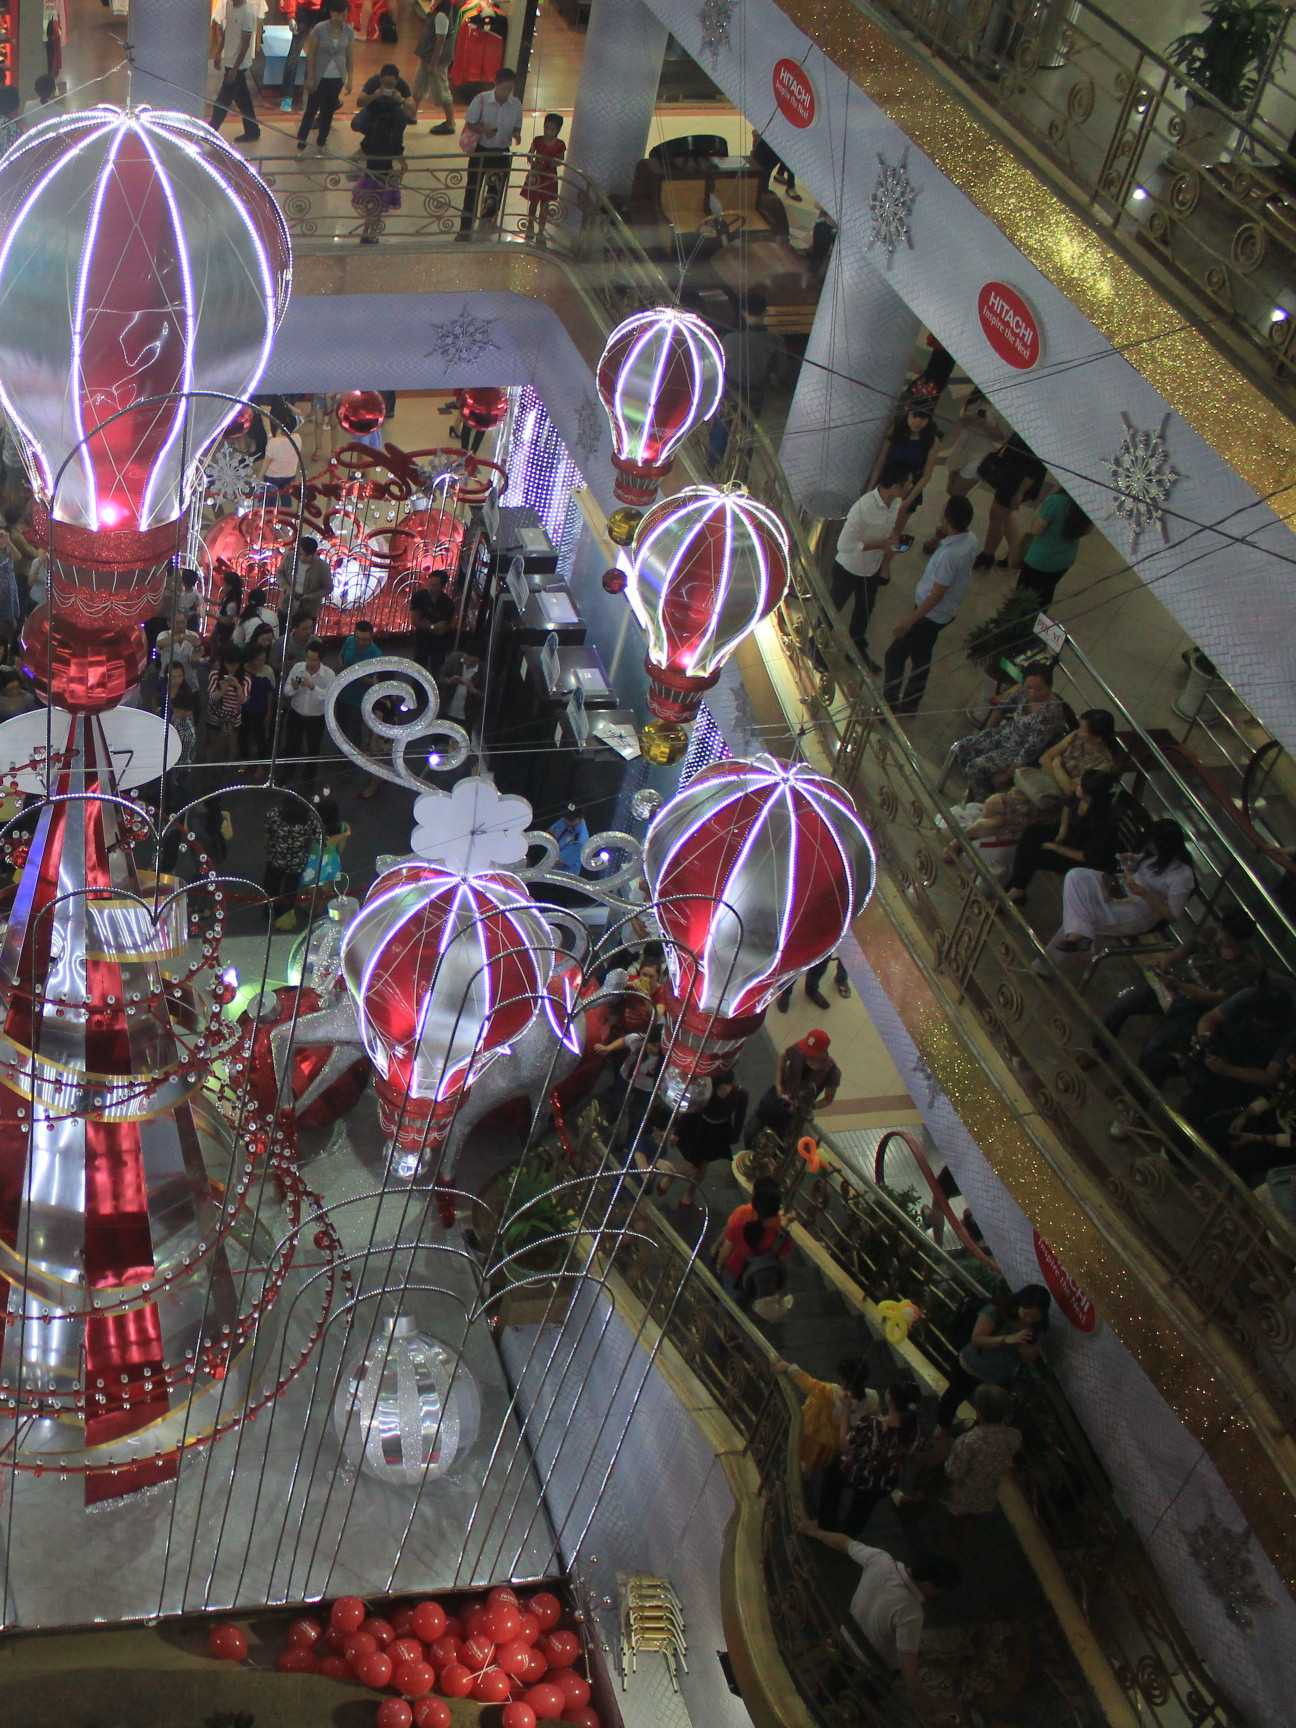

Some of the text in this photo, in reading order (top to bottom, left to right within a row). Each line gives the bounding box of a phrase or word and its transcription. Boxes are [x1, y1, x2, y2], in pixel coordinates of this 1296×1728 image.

[780, 66, 811, 108] HITACHI
[983, 305, 1032, 361] Inspire the Next
[988, 290, 1034, 345] HITACHI
